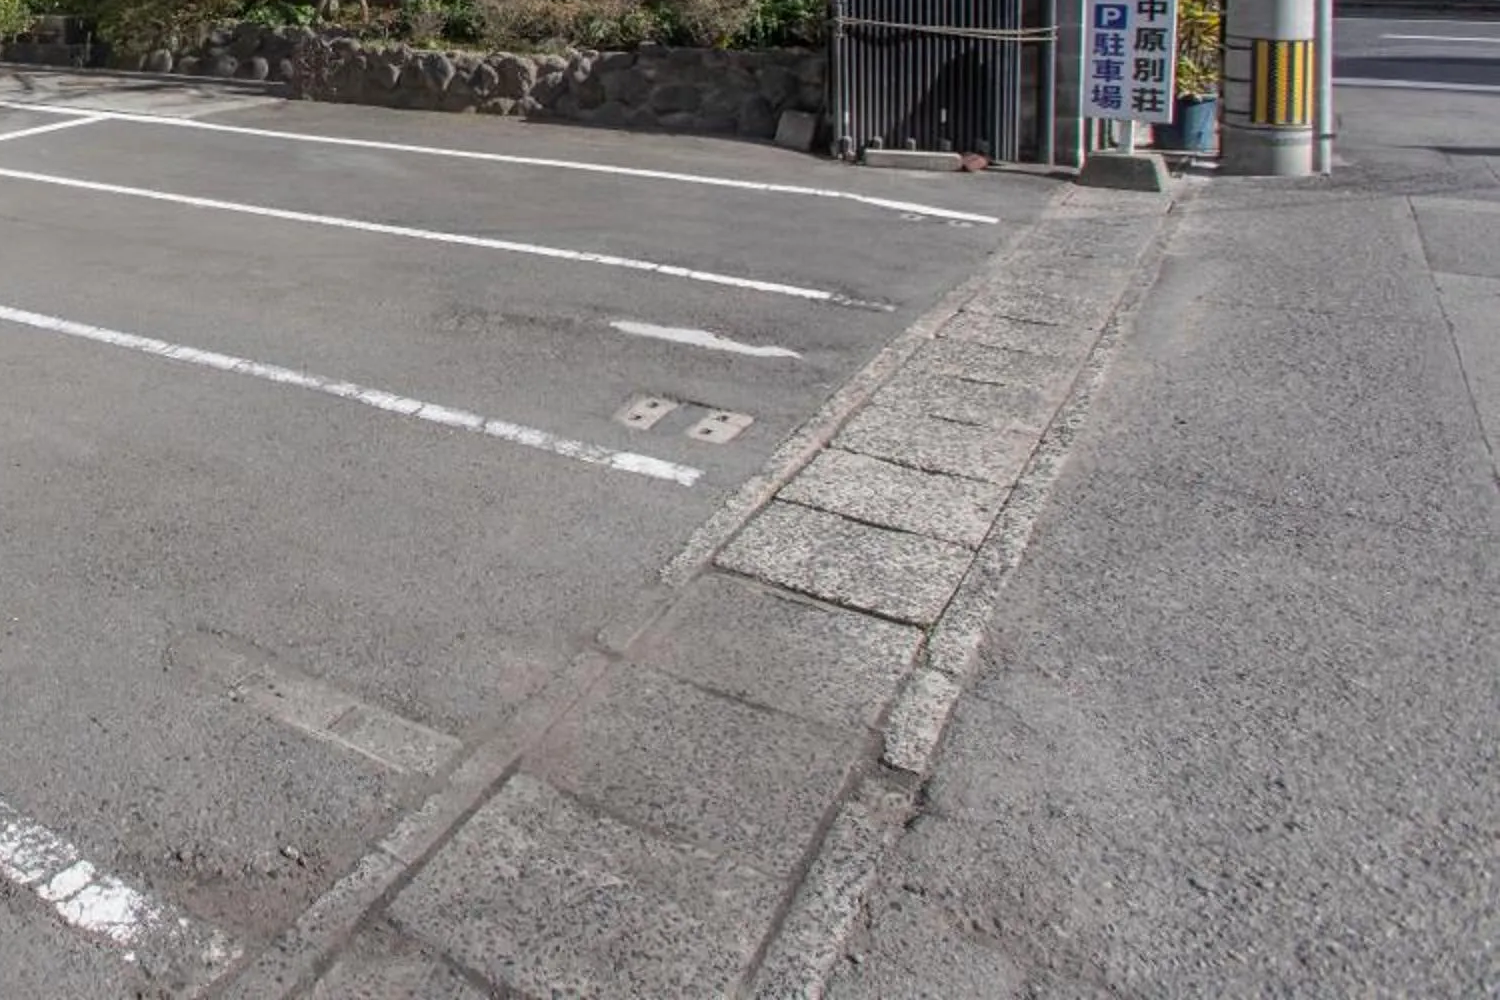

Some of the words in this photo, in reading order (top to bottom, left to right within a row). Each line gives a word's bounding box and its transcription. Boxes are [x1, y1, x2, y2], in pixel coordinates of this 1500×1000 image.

[1102, 7, 1122, 27] P
[1092, 32, 1125, 110] 駐車場
